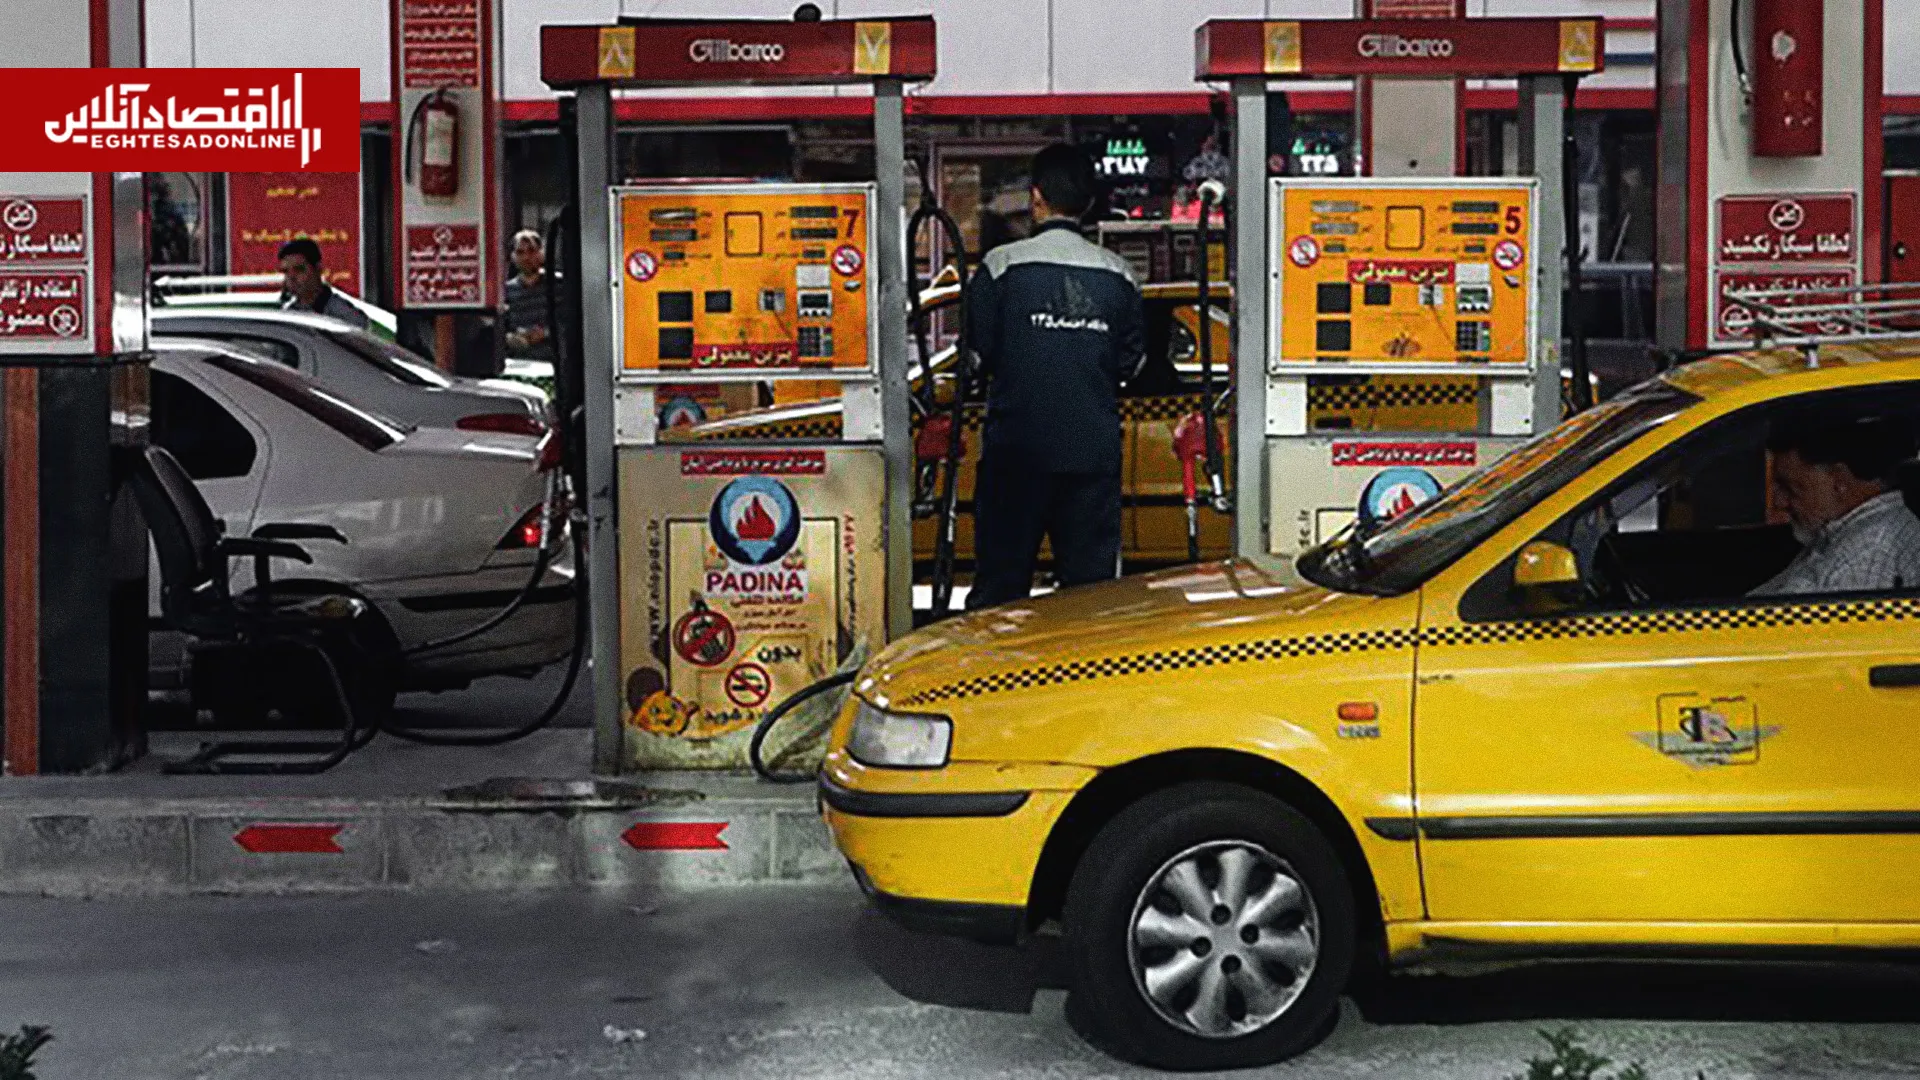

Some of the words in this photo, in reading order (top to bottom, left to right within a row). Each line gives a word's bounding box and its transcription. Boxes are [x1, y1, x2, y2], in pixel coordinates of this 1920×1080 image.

[860, 28, 888, 60] ۷
[843, 208, 860, 238] 7
[1505, 205, 1522, 235] 5
[50, 232, 83, 253] لطفا
[1723, 235, 1770, 260] نکنید
[1816, 232, 1850, 253] لطفا
[1352, 261, 1407, 283] معمولی
[1409, 265, 1449, 283] بنزین
[19, 280, 32, 304] از
[34, 280, 78, 298] استفاده
[698, 345, 751, 366] معمولی
[753, 346, 793, 365] بنزین
[706, 572, 804, 592] PADINA
[757, 645, 802, 663] بدون
